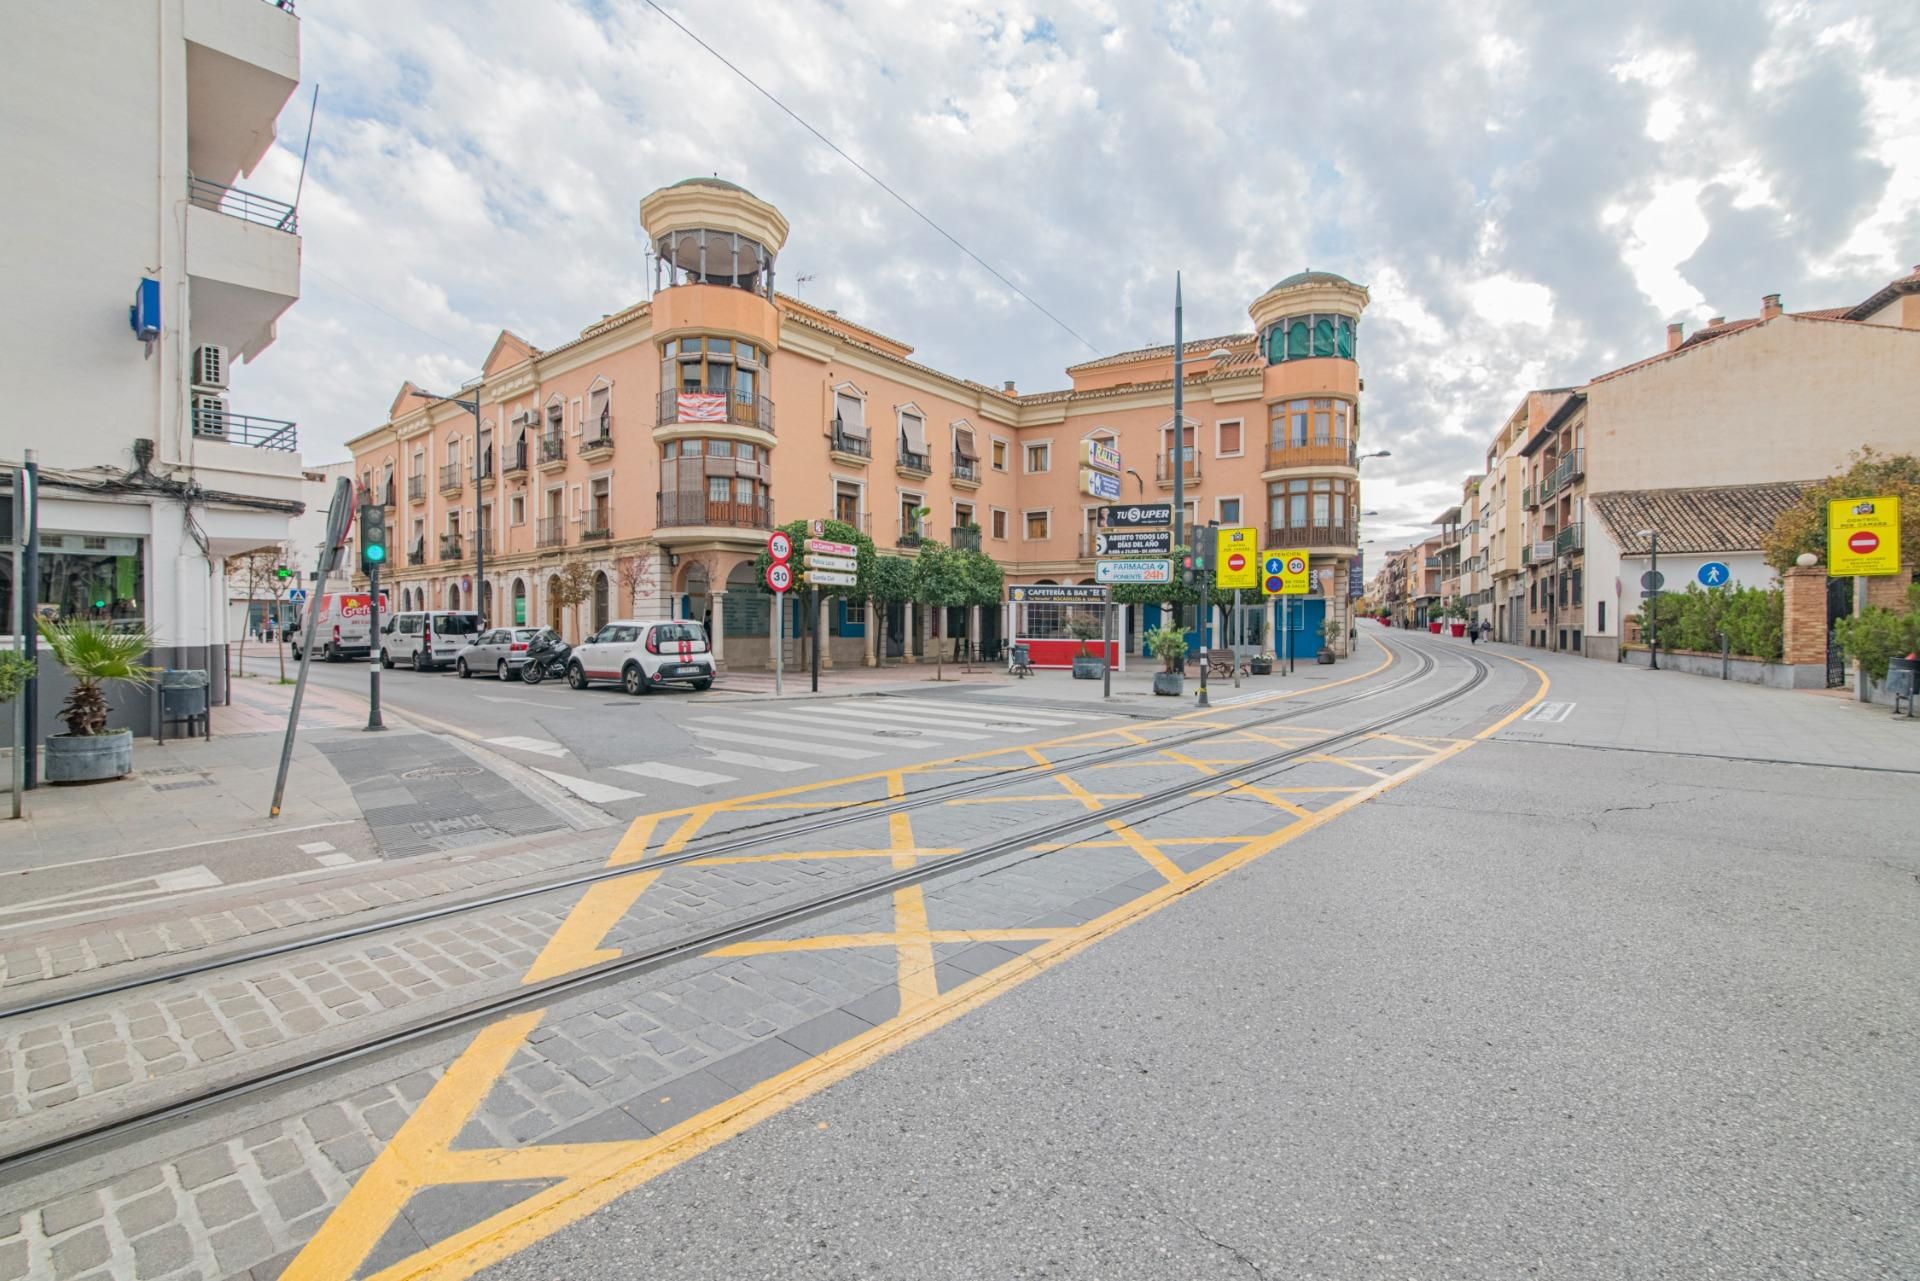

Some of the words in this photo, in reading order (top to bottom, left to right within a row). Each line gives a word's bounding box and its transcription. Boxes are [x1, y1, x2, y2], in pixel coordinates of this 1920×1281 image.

[1117, 511, 1128, 519] TU
[1127, 508, 1169, 522] SUPER
[1157, 532, 1169, 540] LOS
[1144, 539, 1159, 547] AÑO
[773, 571, 788, 582] 30
[1143, 570, 1164, 580] 24h
[1028, 588, 1065, 596] CAFETERÍA
[342, 605, 385, 618] Grefua
